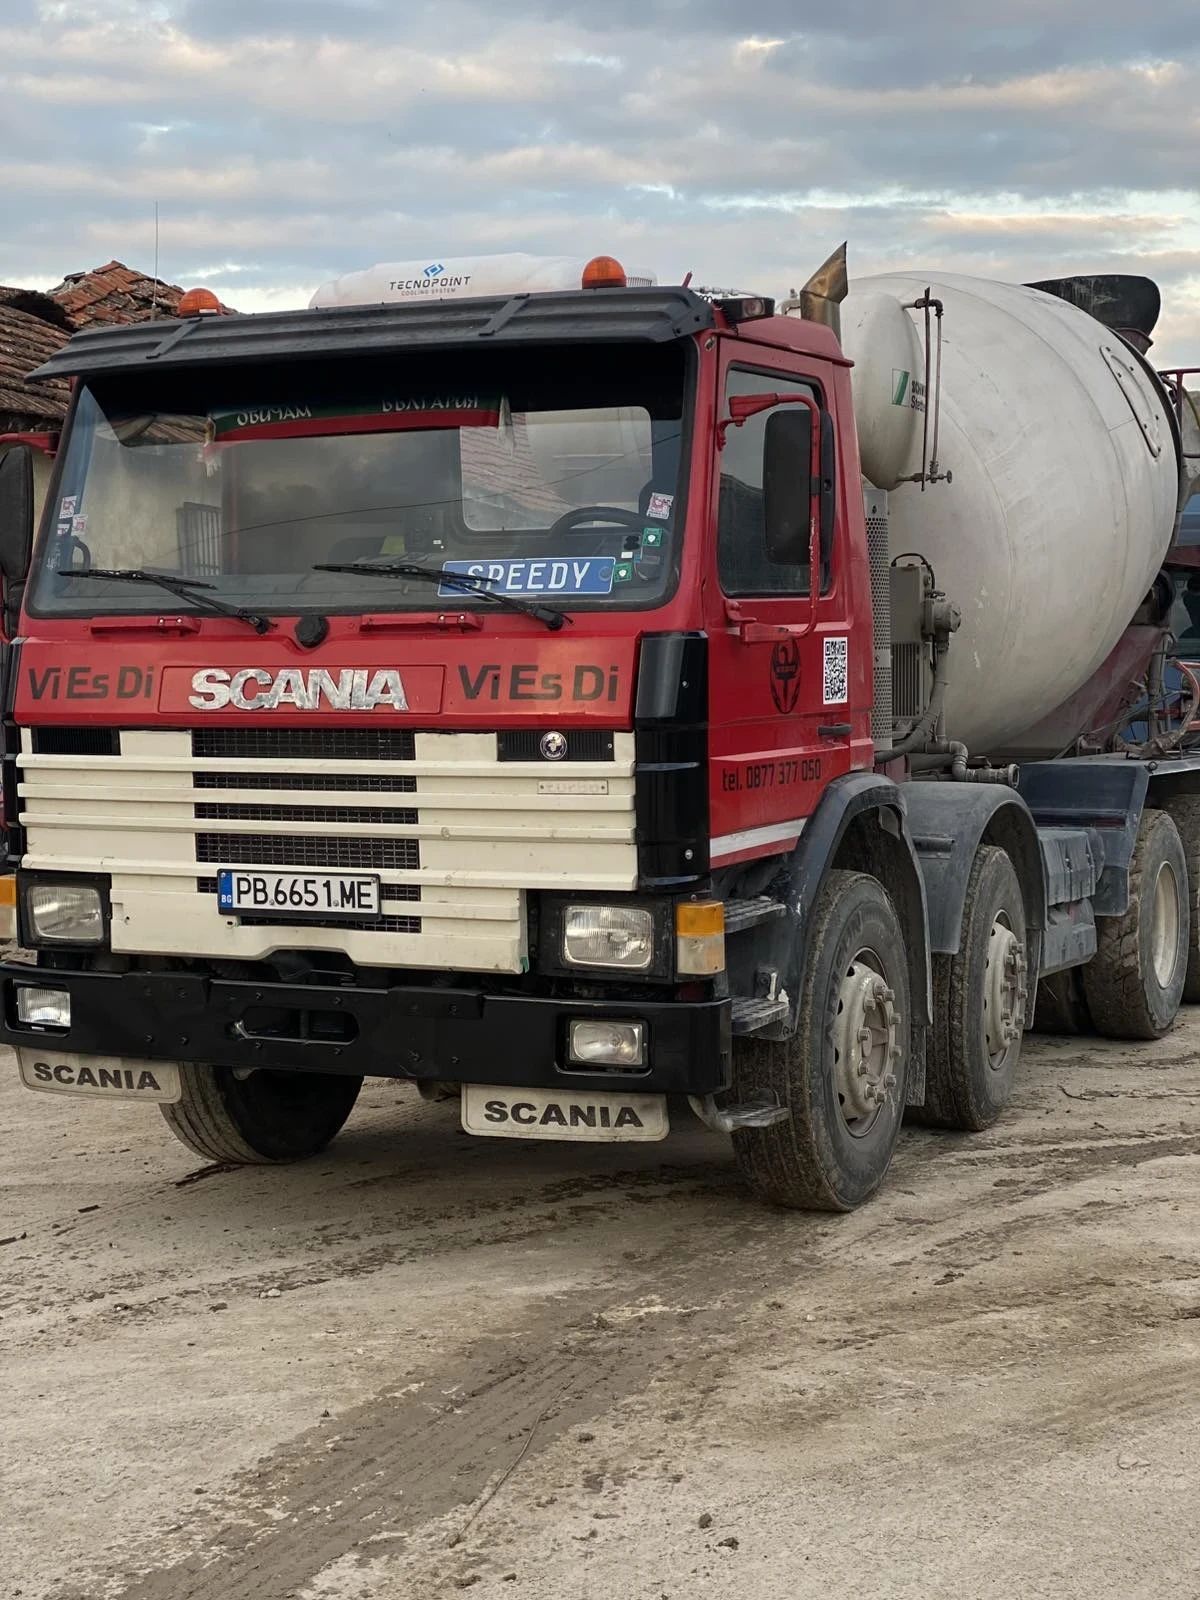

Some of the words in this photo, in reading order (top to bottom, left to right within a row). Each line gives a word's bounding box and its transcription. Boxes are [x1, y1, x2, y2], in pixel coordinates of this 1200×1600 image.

[467, 562, 591, 591] SPEEDY
[188, 668, 410, 711] SCANIA
[722, 768, 743, 792] tel.
[746, 763, 775, 789] 0877
[779, 760, 799, 785] 377
[802, 758, 821, 782] 050
[221, 894, 232, 904] BG
[33, 1062, 161, 1091] SCANIA
[484, 1100, 644, 1128] SCANIA
